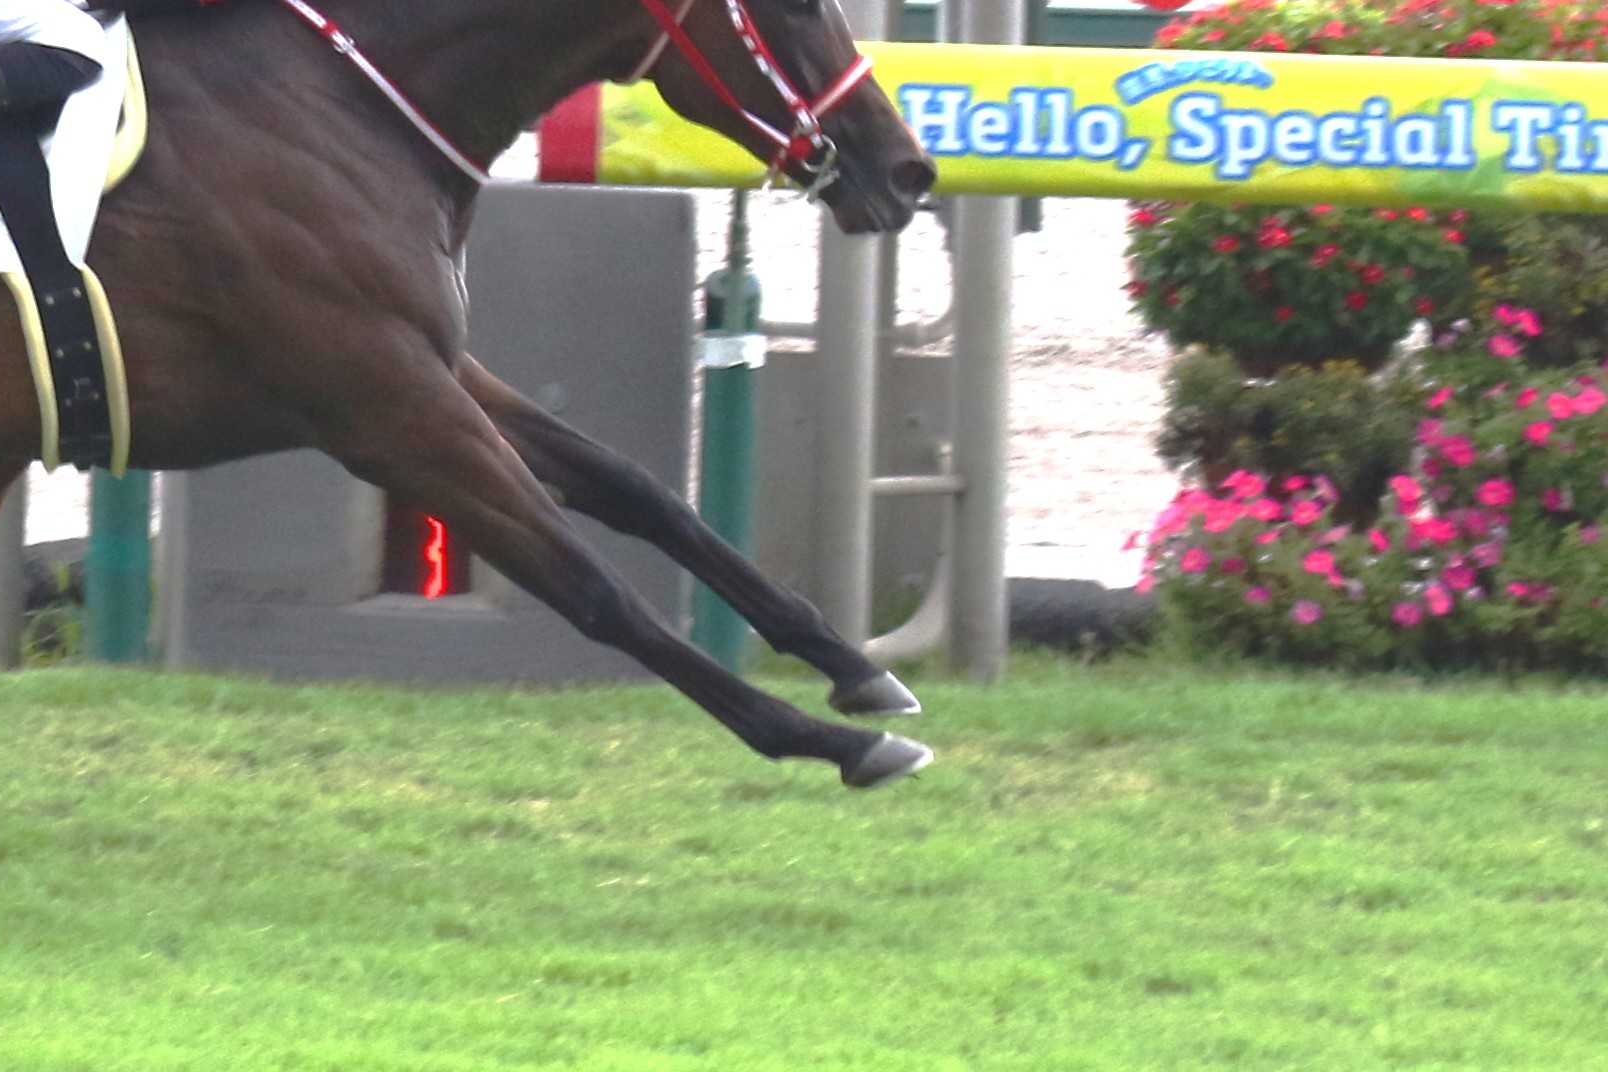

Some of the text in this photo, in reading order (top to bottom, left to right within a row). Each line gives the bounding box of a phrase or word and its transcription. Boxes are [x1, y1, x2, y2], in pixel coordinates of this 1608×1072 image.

[899, 83, 1150, 169] Hello,
[1169, 92, 1475, 180] Special
[1491, 100, 1608, 174] Ti
